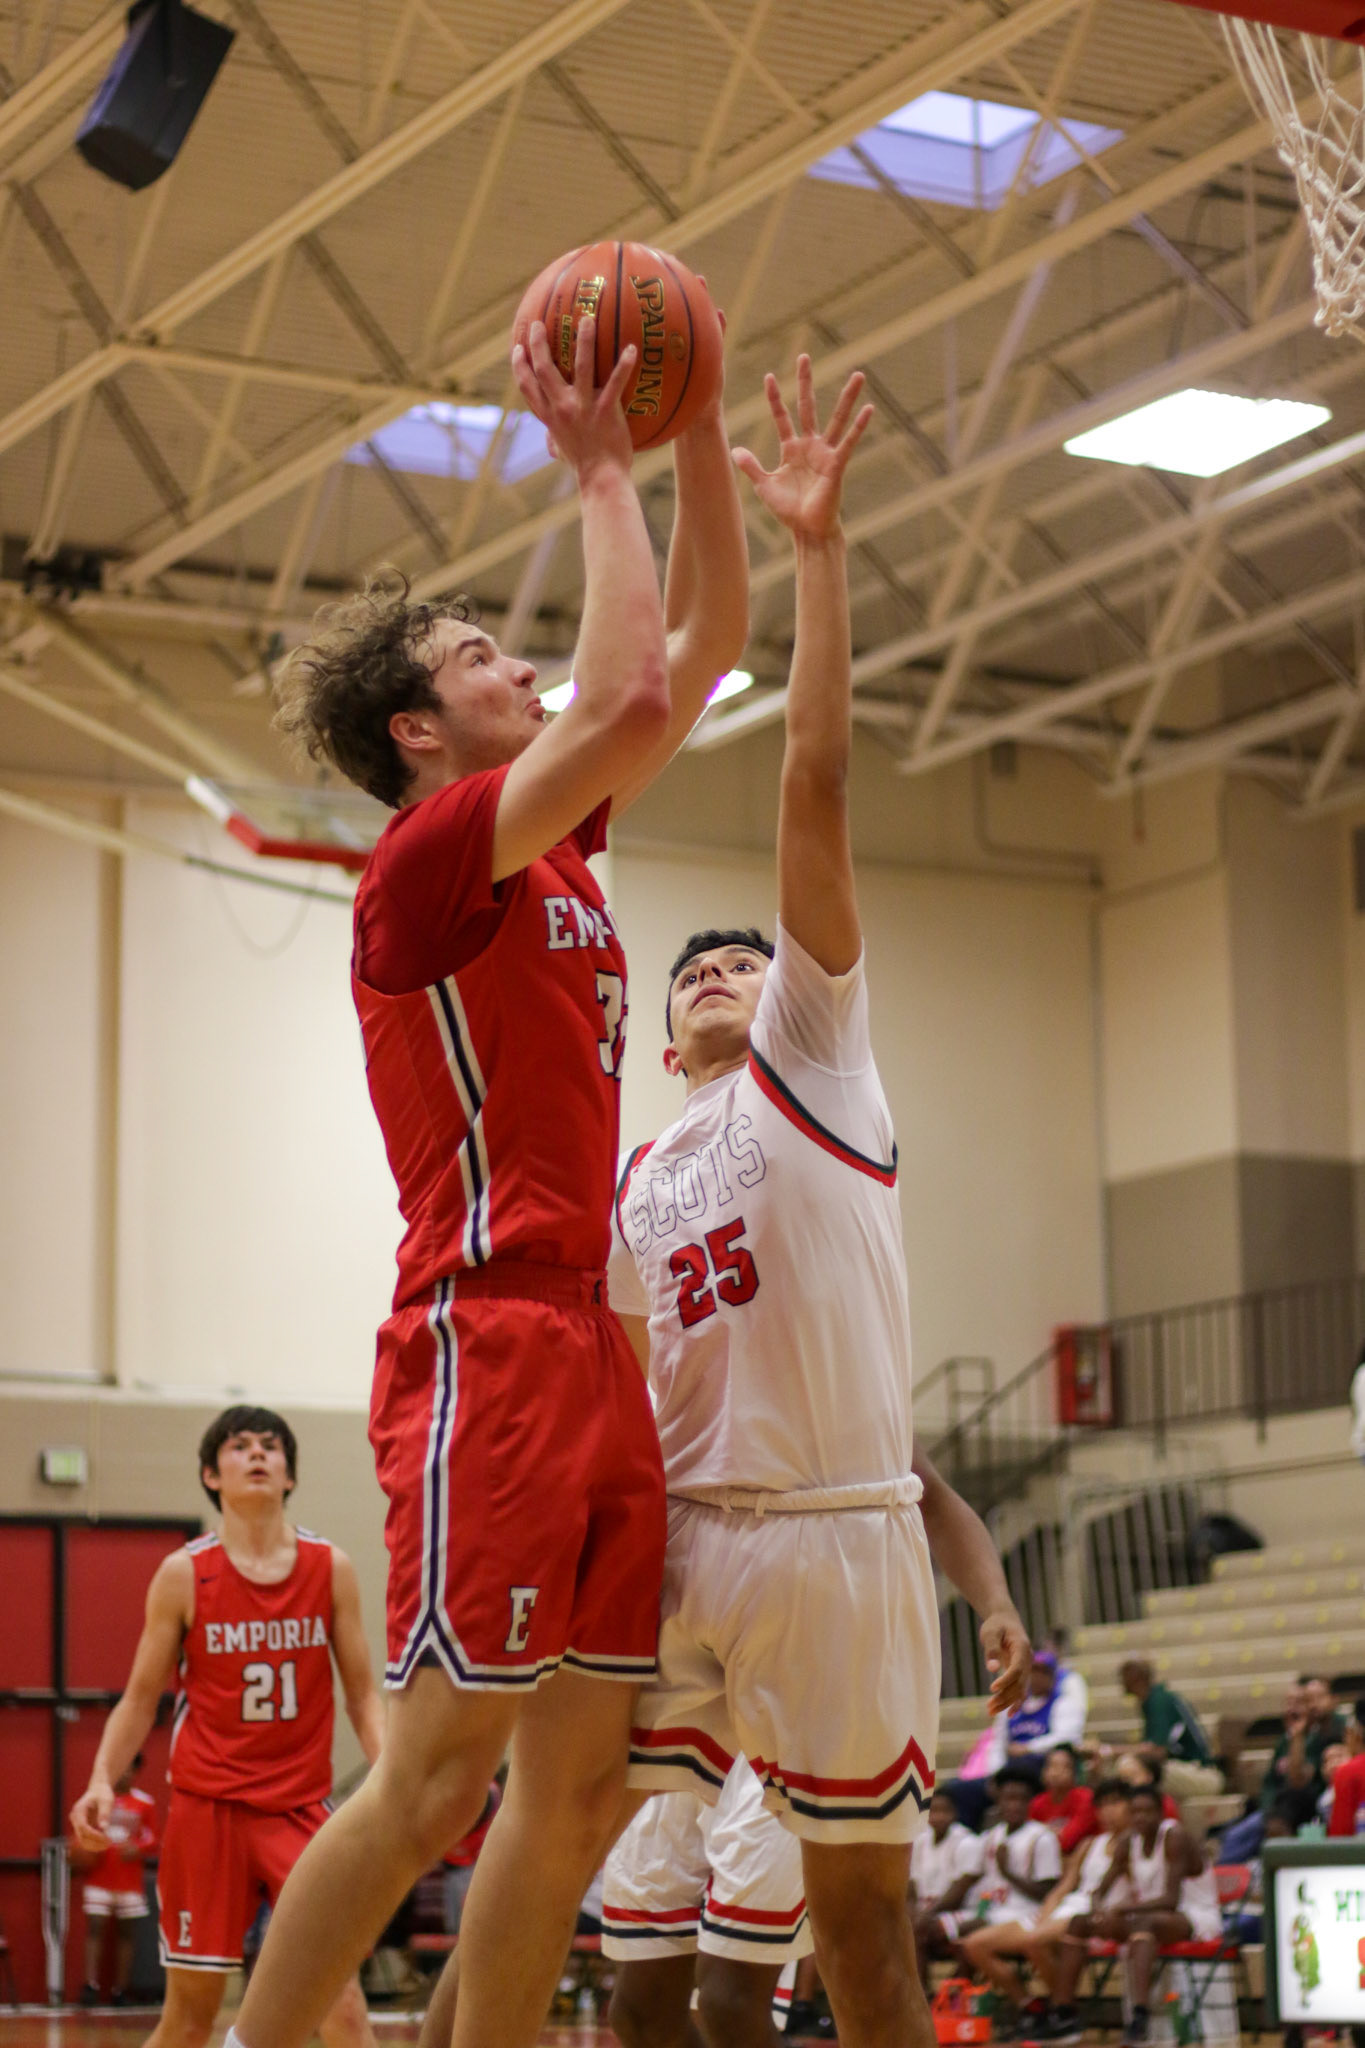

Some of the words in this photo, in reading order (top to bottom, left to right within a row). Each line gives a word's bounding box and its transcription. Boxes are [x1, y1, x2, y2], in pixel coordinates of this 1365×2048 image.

[561, 314, 573, 370] LEGACY
[627, 275, 664, 416] SPALDING
[630, 1113, 767, 1256] SCOTS
[669, 1215, 760, 1330] 25
[204, 1614, 328, 1655] EMPORIA
[504, 1585, 540, 1653] E
[241, 1659, 299, 1722] 21
[178, 1910, 192, 1947] E
